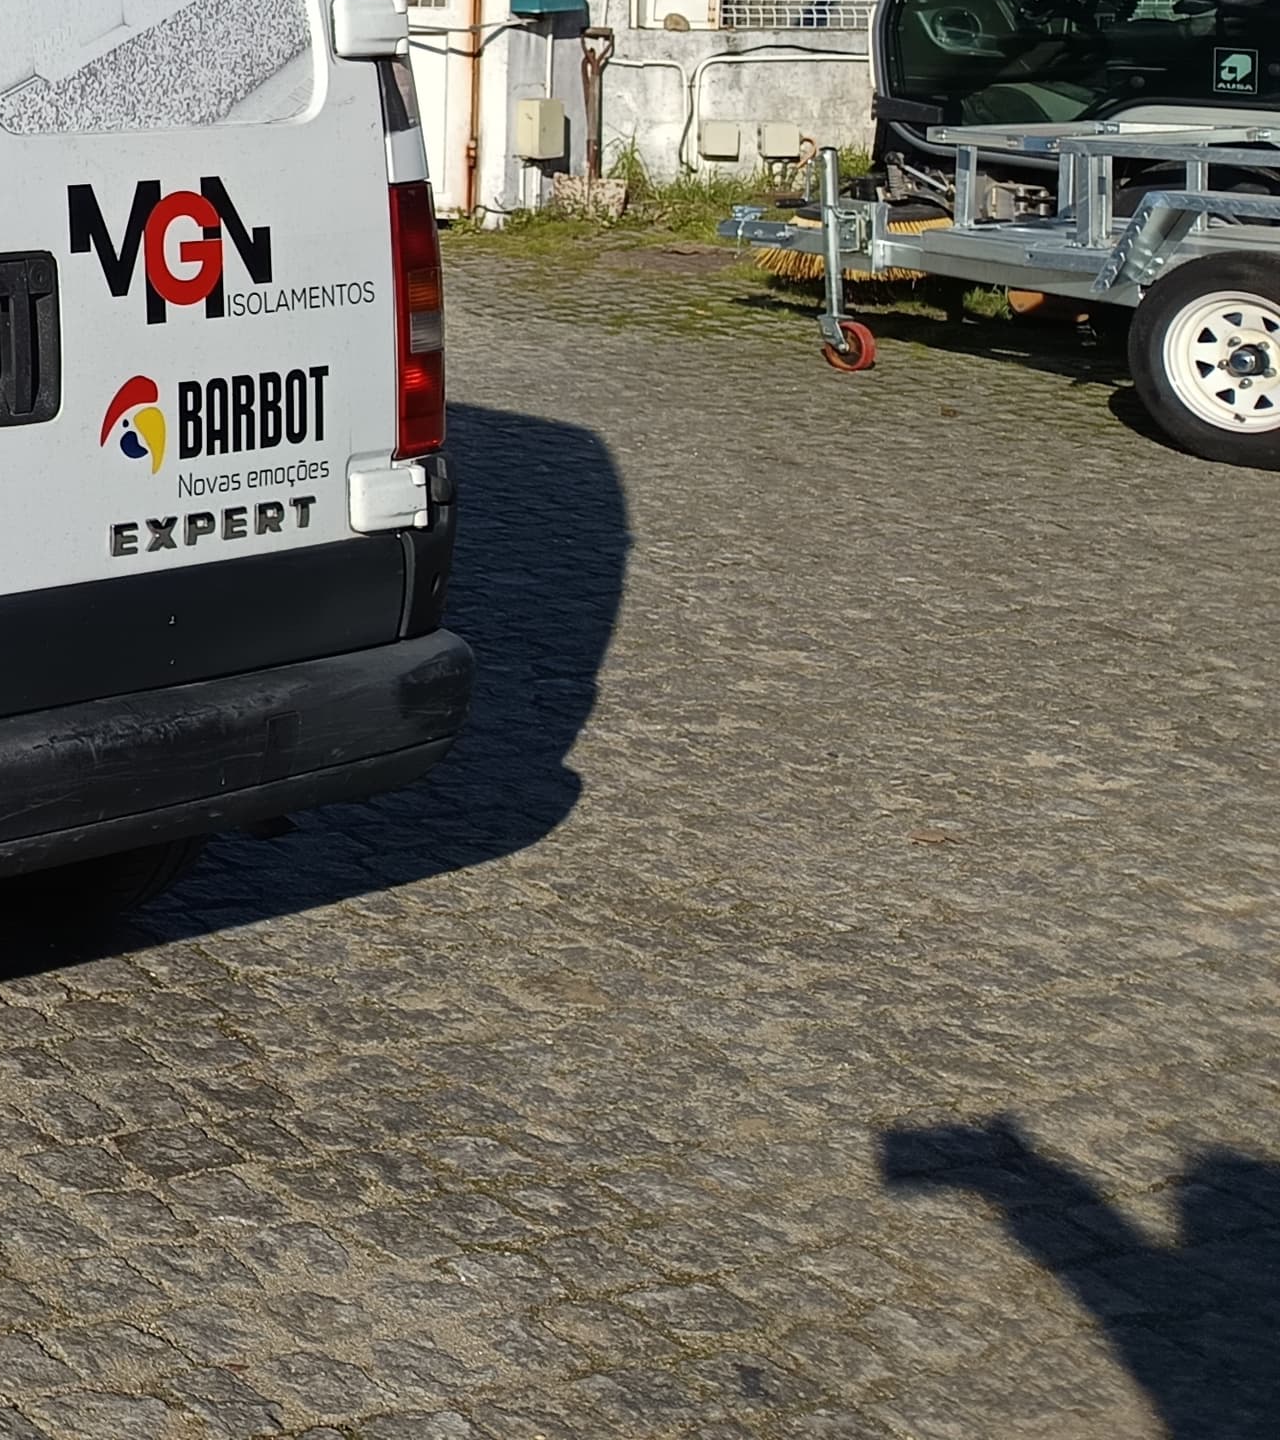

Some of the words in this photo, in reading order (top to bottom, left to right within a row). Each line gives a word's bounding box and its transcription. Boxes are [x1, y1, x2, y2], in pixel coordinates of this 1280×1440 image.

[67, 176, 273, 325] MGN
[227, 280, 375, 317] ISOLAMENTOS
[178, 365, 329, 460] BARBOT
[178, 473, 241, 498] Novas
[247, 460, 330, 489] emoções
[110, 495, 316, 557] EXPERT
